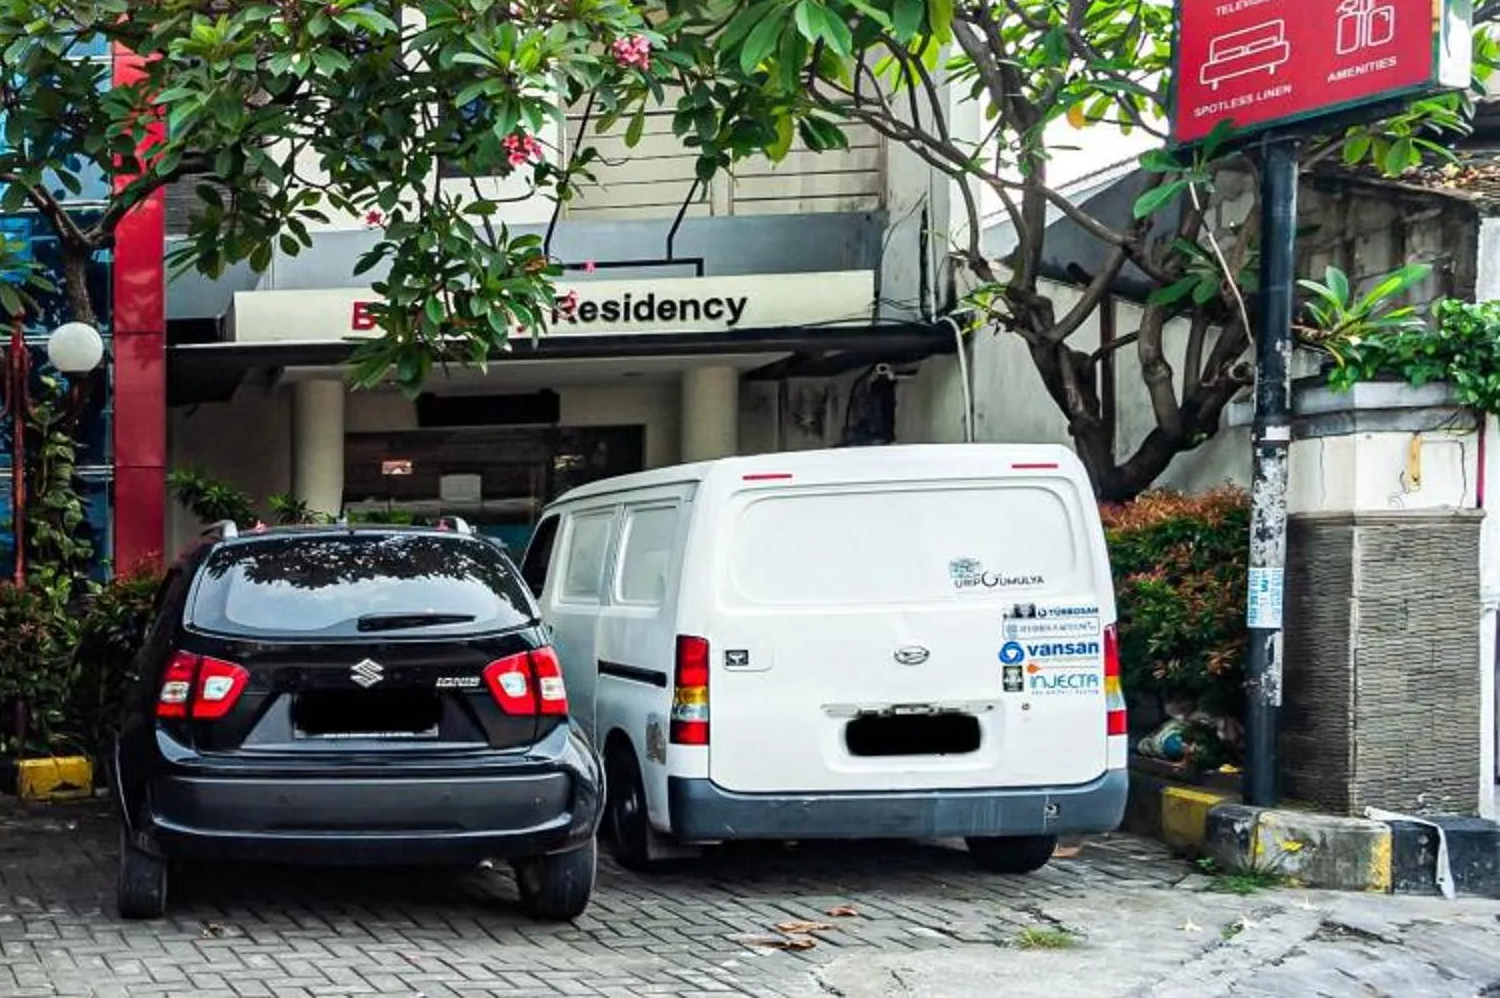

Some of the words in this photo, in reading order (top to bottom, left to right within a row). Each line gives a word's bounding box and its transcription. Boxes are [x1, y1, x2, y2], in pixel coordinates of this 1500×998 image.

[1327, 55, 1397, 83] AMENITIES
[1193, 93, 1253, 118] SPOTLESS
[1256, 83, 1292, 101] LINEN
[551, 293, 748, 326] Residency
[1027, 642, 1099, 657] vansan
